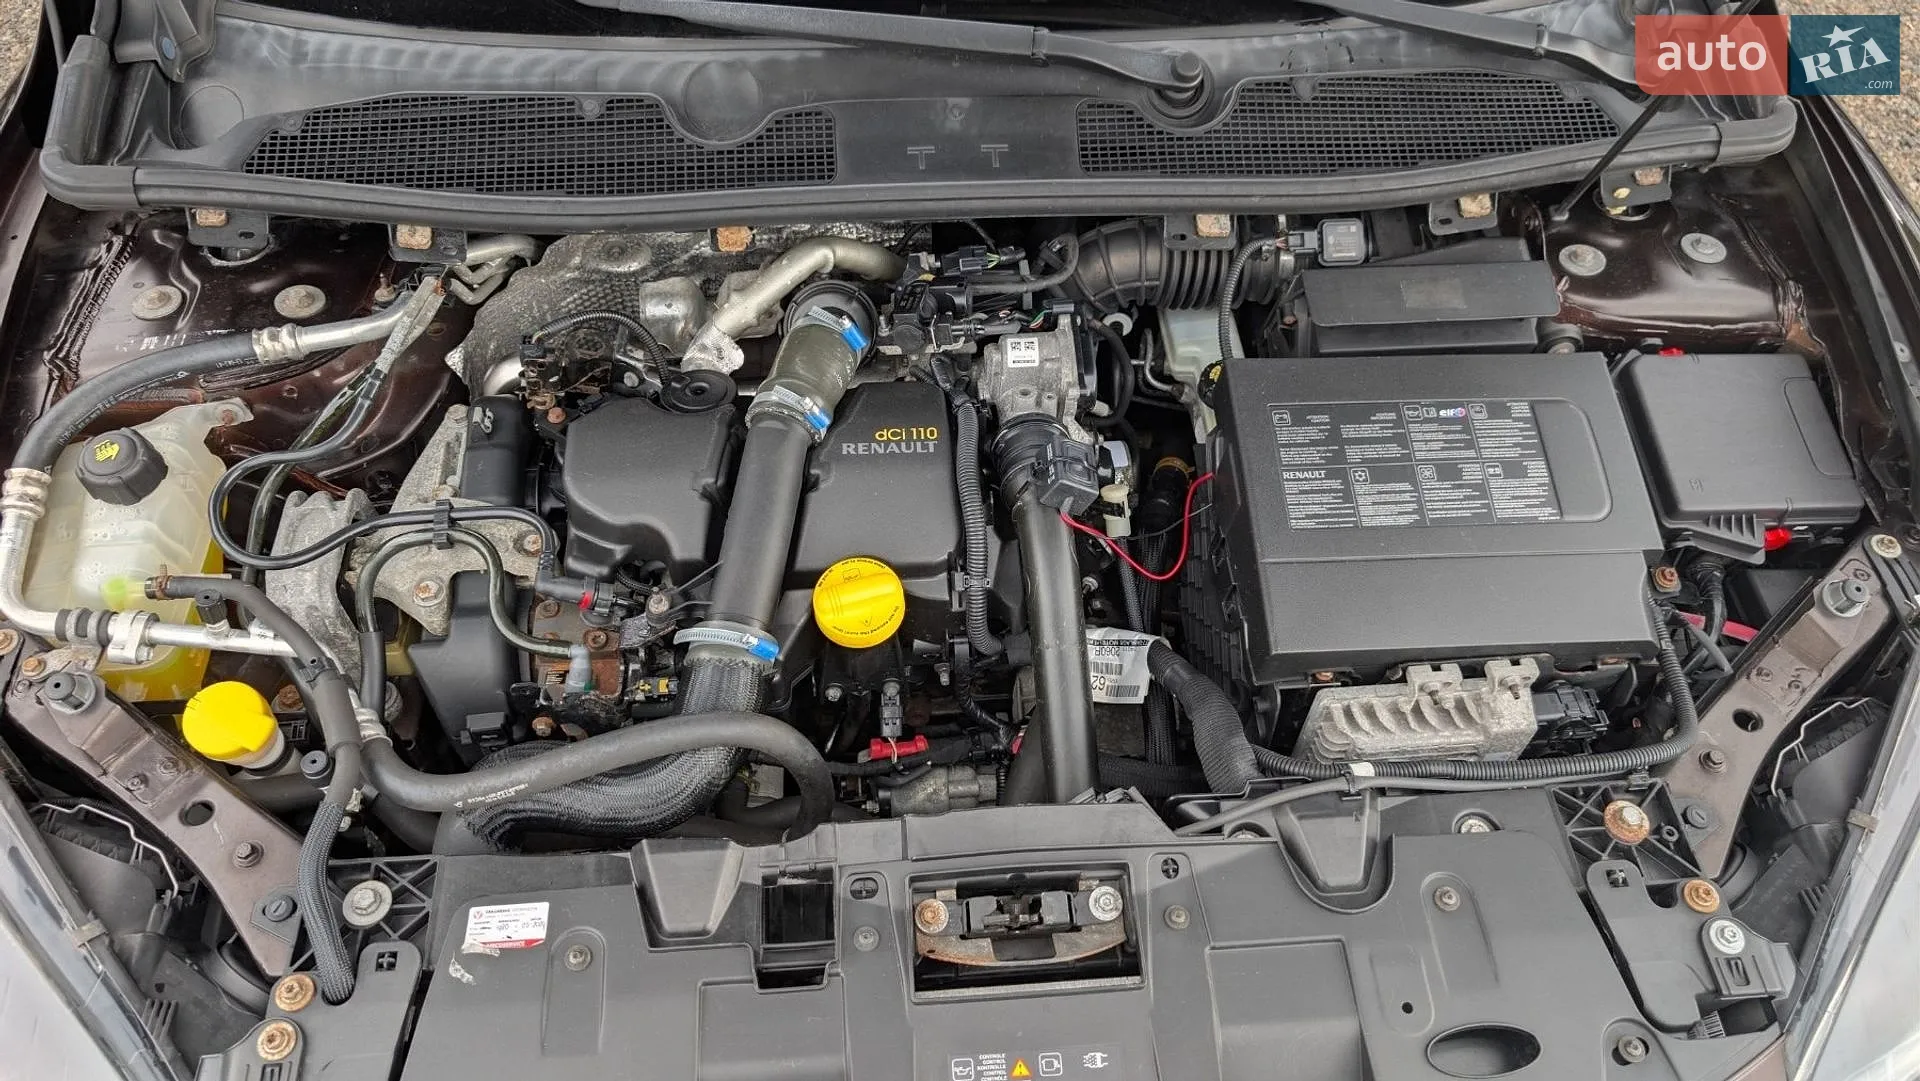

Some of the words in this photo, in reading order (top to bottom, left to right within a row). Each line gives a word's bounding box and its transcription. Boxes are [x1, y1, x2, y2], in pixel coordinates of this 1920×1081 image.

[875, 427, 906, 441] dCi
[910, 427, 938, 440] 110
[841, 441, 938, 455] RENAULT
[1282, 470, 1327, 479] RENAULT
